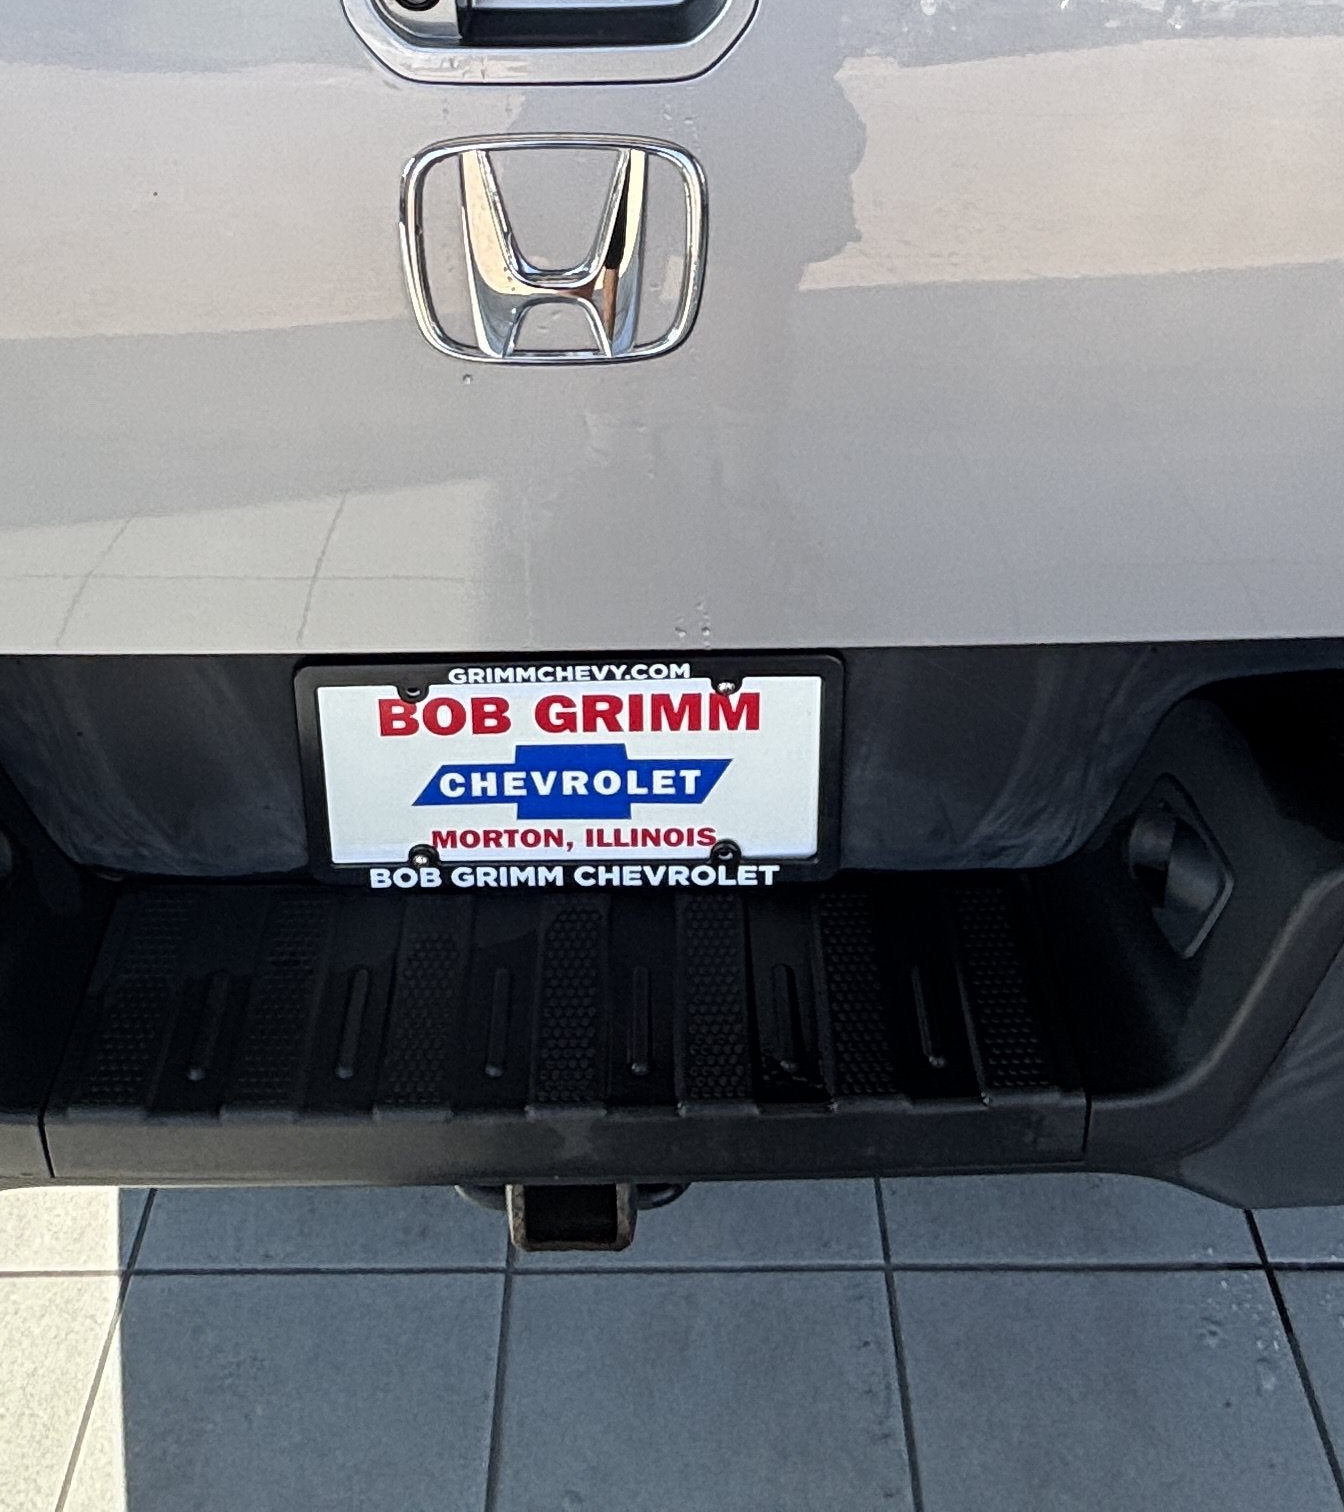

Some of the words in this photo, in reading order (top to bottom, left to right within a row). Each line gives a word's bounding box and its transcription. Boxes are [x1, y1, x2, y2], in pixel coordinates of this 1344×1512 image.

[447, 663, 691, 685] GRIMMCHEVY.COM
[378, 696, 512, 737] BOB
[534, 692, 760, 734] GRIMM
[439, 769, 702, 798] CHEVROLET
[432, 828, 574, 852] MORTON,
[585, 827, 718, 848] ILLINOIS
[370, 867, 442, 888] BOB
[450, 866, 564, 888] GRIMM
[573, 865, 780, 887] CHEVROLET
